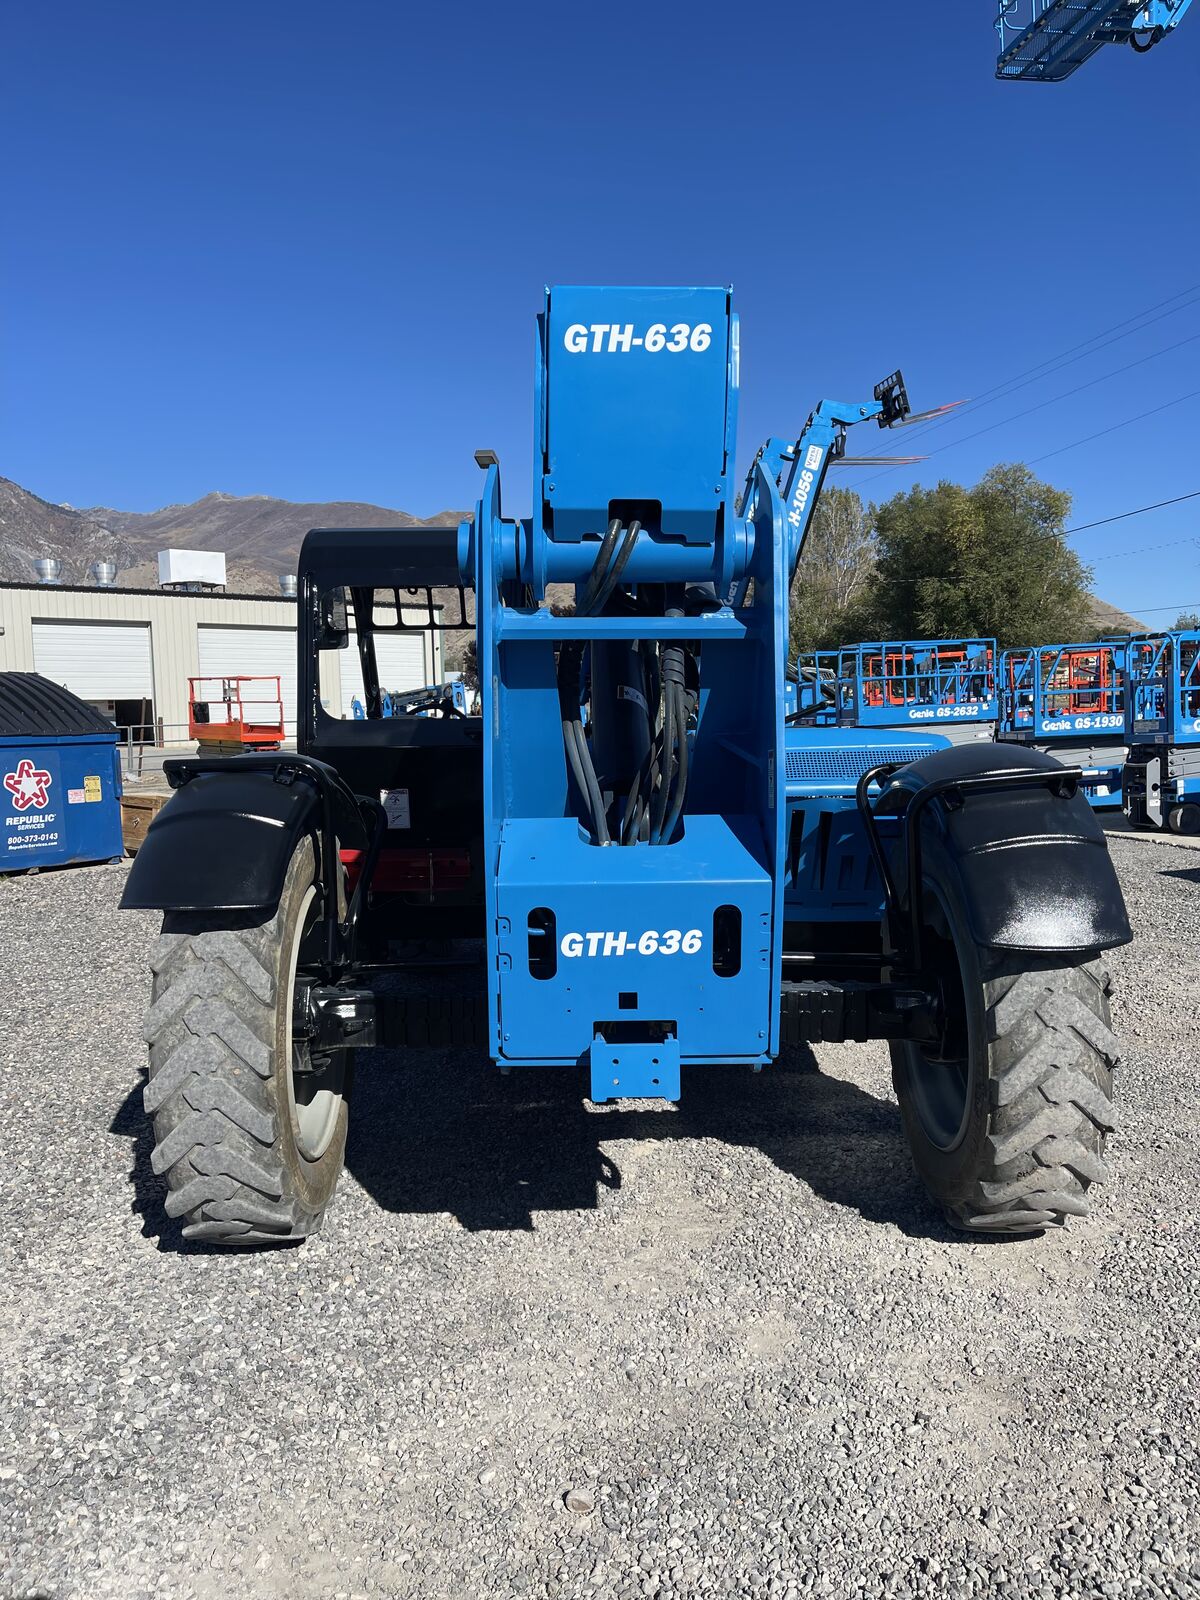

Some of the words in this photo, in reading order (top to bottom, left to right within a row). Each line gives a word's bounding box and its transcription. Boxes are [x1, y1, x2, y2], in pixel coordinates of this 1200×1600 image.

[563, 323, 713, 353] GTH-636
[788, 470, 813, 528] H-1056
[723, 581, 740, 606] Gen
[909, 709, 934, 719] Genie
[936, 705, 979, 717] GS-2632
[1041, 720, 1071, 731] Genie
[1074, 715, 1123, 729] GS-1930
[5, 813, 55, 826] REPUBLIC
[17, 823, 45, 831] SERVICES
[7, 832, 58, 845] 800-373-0143
[560, 929, 703, 958] GTH-636
